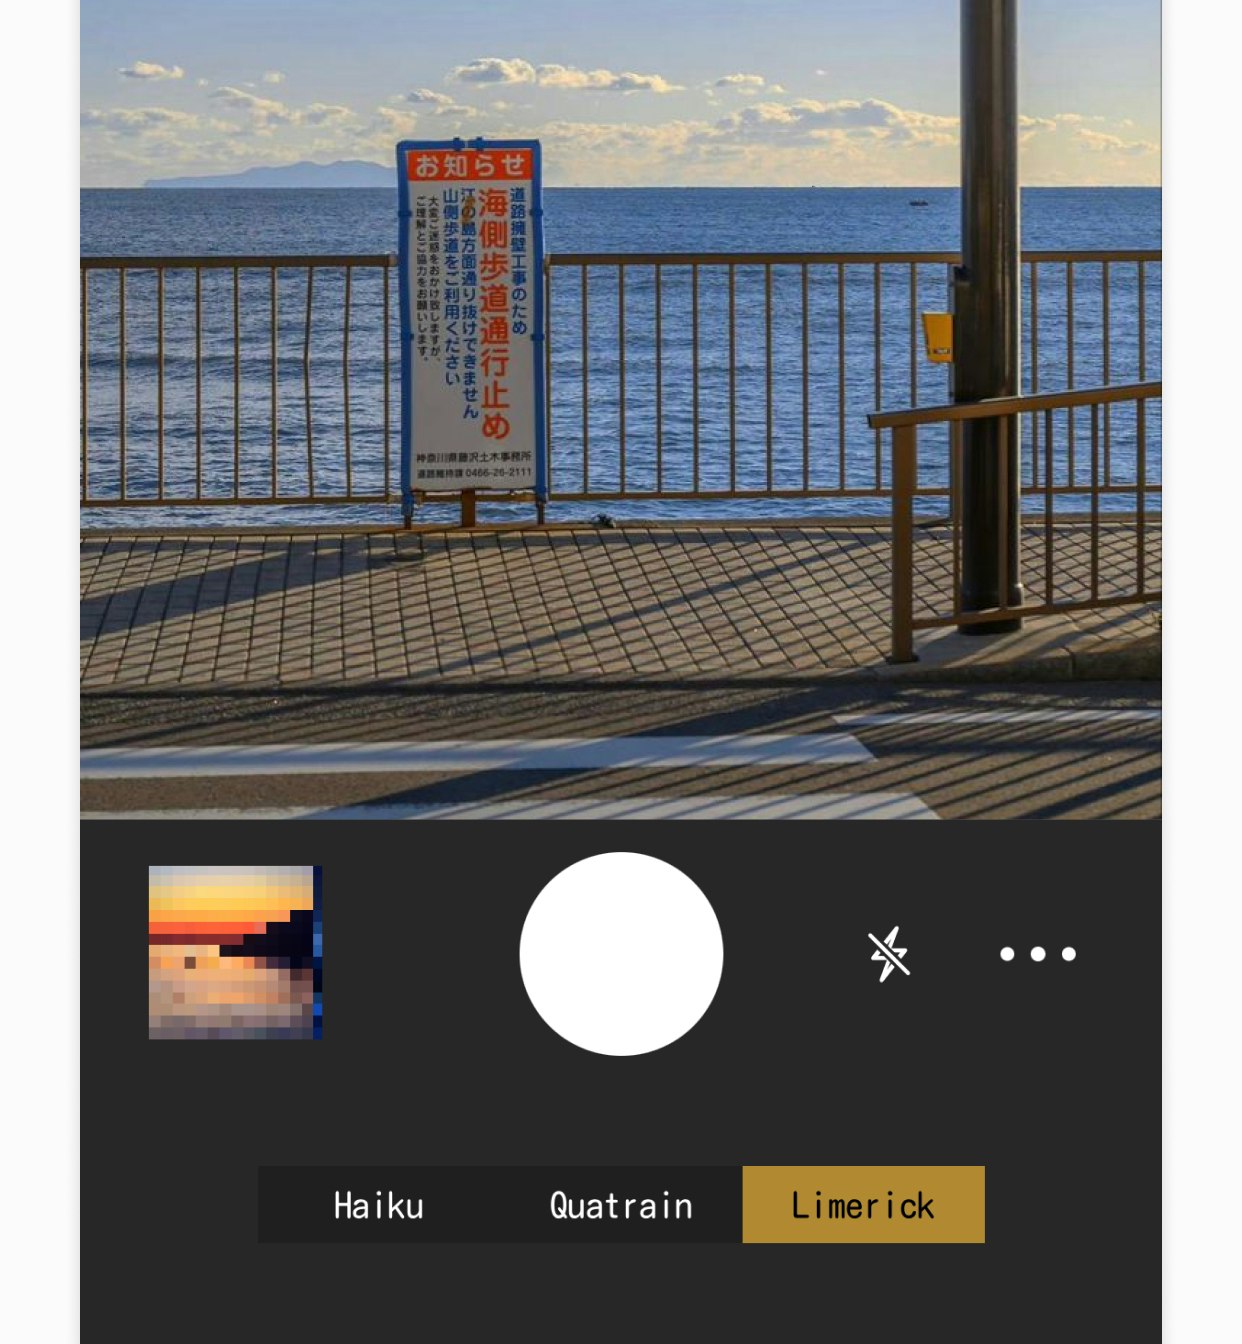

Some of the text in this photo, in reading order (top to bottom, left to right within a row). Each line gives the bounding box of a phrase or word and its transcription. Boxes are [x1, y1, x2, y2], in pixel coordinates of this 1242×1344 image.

[416, 154, 525, 178] お知らせ
[443, 188, 460, 386] 山側歩道をご利用ください
[510, 187, 527, 335] 道路擁壁工事のため
[478, 189, 511, 439] 海側歩道通行止め
[416, 451, 532, 463] 神奈川県藤沢土木事務所
[334, 1190, 935, 1220] Haiku Quatrain Limerick
